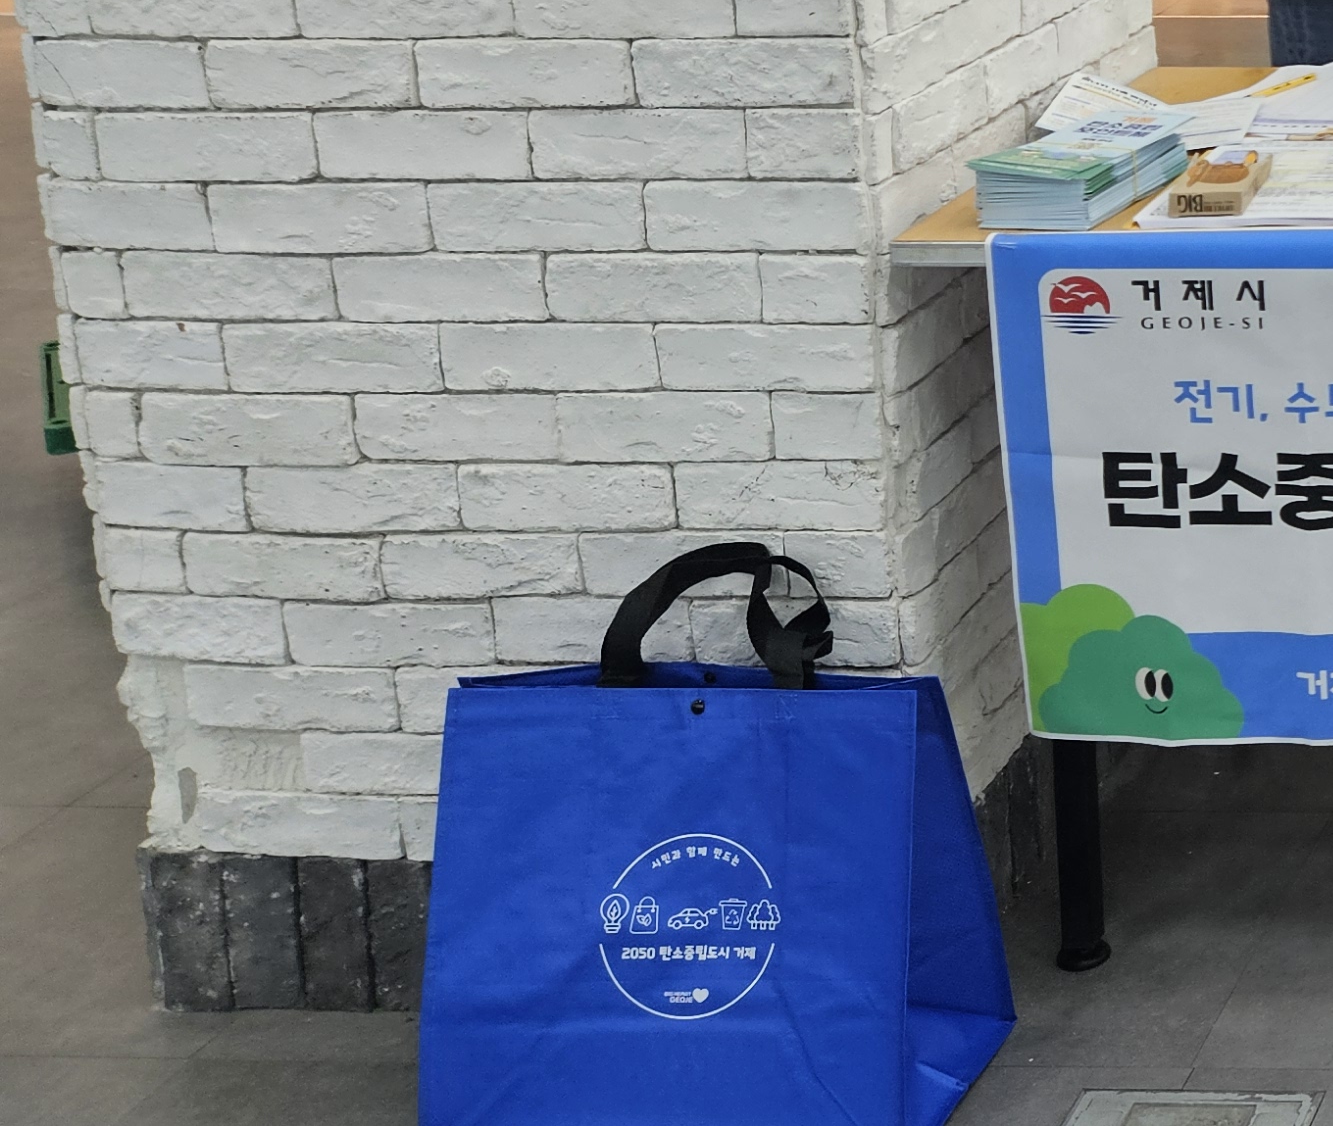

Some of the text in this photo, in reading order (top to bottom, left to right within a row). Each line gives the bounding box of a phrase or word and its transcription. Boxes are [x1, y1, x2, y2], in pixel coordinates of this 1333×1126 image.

[1131, 279, 1267, 313] 거제시
[1140, 315, 1265, 331] GEOJE-SI
[1172, 379, 1271, 425] 전기,
[651, 846, 741, 869] 시민과 함께 만드는
[621, 945, 757, 961] 2050 탄소중립도시 거제
